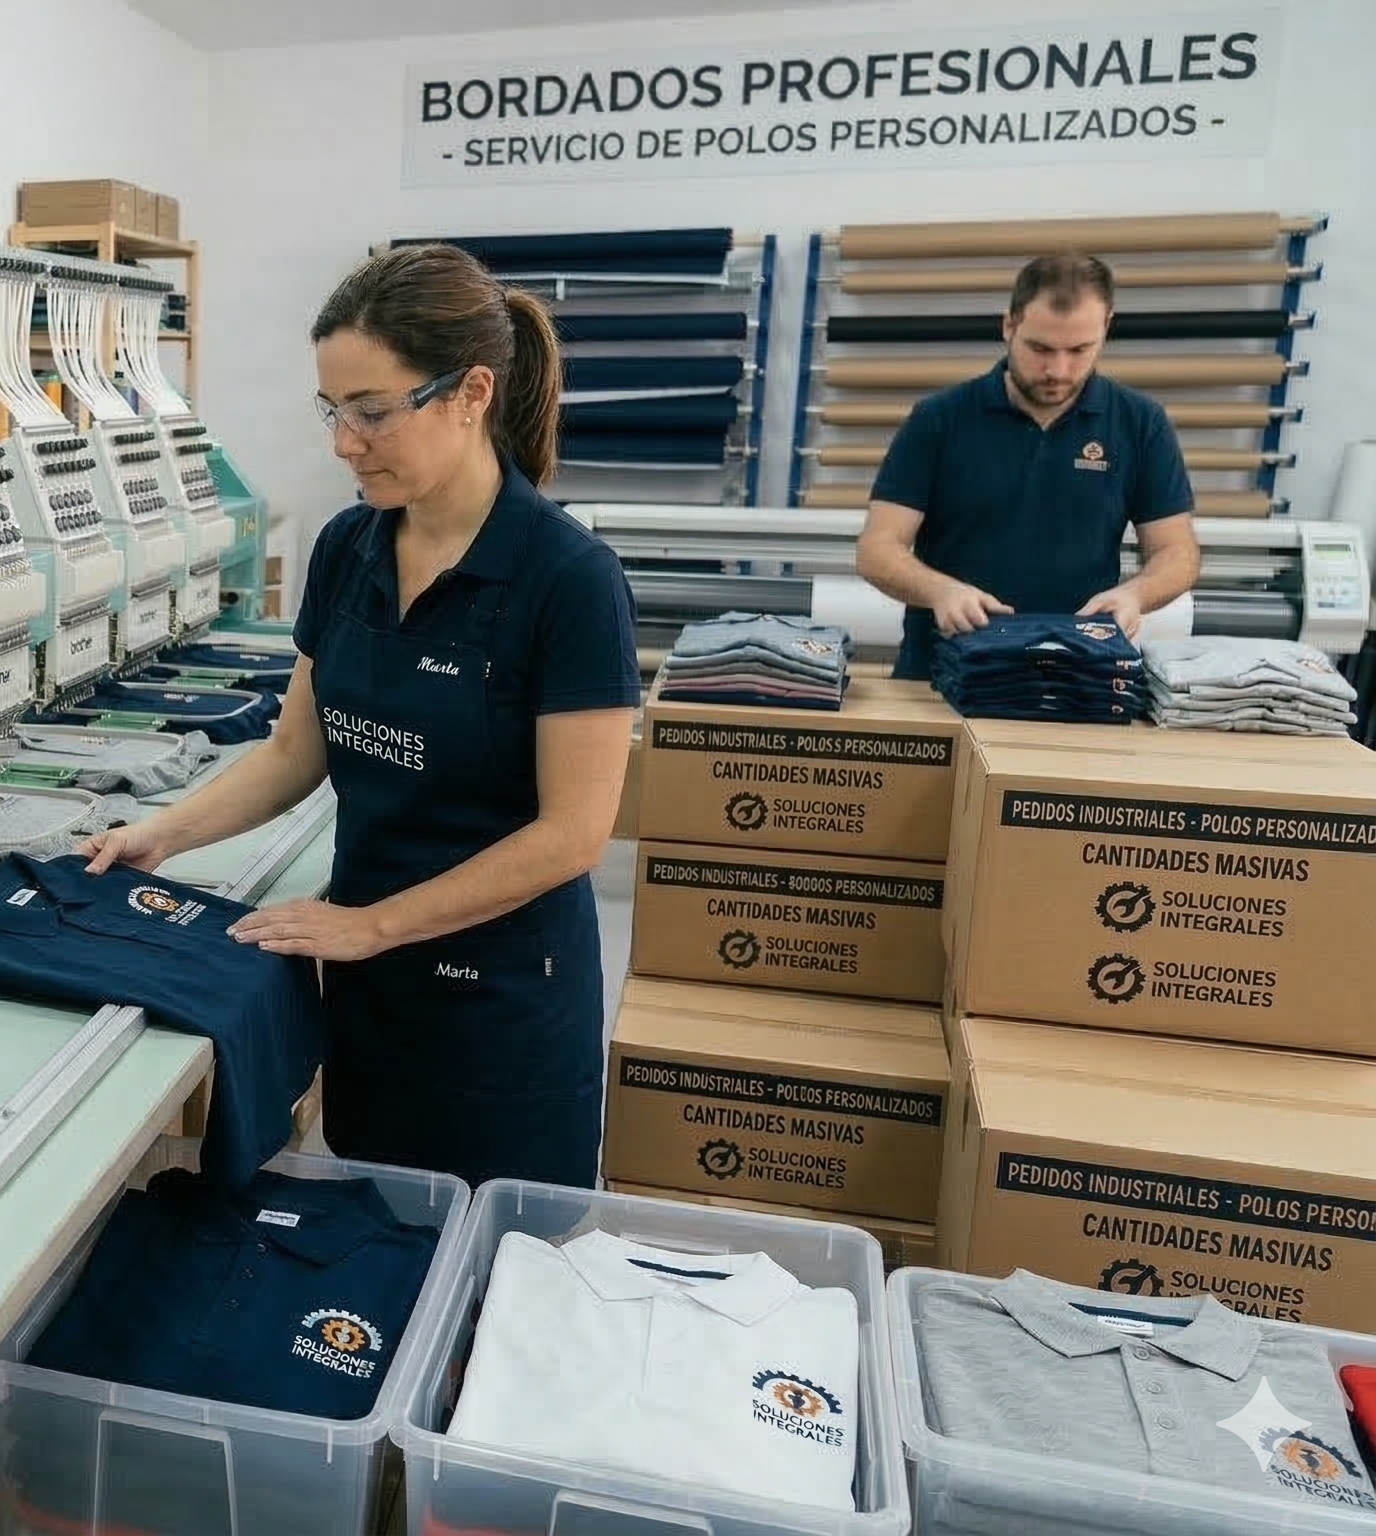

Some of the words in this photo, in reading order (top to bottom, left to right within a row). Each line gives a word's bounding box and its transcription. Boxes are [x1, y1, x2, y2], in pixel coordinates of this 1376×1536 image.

[421, 65, 723, 122] BORDADOS
[742, 32, 1258, 105] PROFESIONALES
[464, 132, 625, 166] SERVICIO
[637, 128, 683, 159] DE
[694, 122, 817, 156] POLOS
[830, 104, 1197, 151] PERSONALIZADOS
[323, 707, 424, 751] SOLUCIONES
[659, 727, 705, 745] PEDIDOS
[708, 730, 787, 750] INDUSTRIALES
[844, 738, 946, 760] PERSONALIZADOS
[327, 726, 424, 770] INTEGRALES
[713, 760, 809, 784] CANTIDADES
[812, 767, 884, 790] MASIVAS
[773, 799, 866, 818] SOLUCIONES
[773, 815, 865, 834] INTEGRALES
[1013, 800, 1075, 823] PEDIDOS
[1079, 804, 1186, 831] INDUSTRIALES
[1201, 813, 1252, 836] POLOS
[1082, 842, 1209, 874] CANTIDADES
[1215, 853, 1310, 882] MASIVAS
[653, 863, 699, 882] PEDIDOS
[701, 868, 778, 888] INDUSTRIALES
[835, 879, 935, 901] PERSONALIZADOS
[706, 898, 802, 923] CANTIDADES
[805, 907, 877, 930] MASIVAS
[1161, 890, 1287, 916] SOLUCIONES
[1160, 911, 1285, 938] INTEGRALES
[765, 936, 858, 957] SOLUCIONES
[765, 952, 858, 974] INTEGRALES
[434, 961, 479, 980] Marta
[1153, 961, 1277, 987] SOLUCIONES
[1151, 982, 1274, 1008] INTEGRALES
[626, 1064, 677, 1086] PEDIDOS
[679, 1071, 765, 1097] INDUSTRIALES
[683, 1103, 786, 1134] CANTIDADES
[790, 1117, 864, 1145] MASIVAS
[747, 1163, 845, 1190] INTEGRALES
[748, 1147, 847, 1173] SOLUCIONES
[1008, 1162, 1083, 1192] PEDIDOS
[1088, 1173, 1220, 1210] INDUSTRIALES
[1238, 1193, 1301, 1221] POLOS
[1083, 1212, 1222, 1254] CANTIDADES
[1228, 1233, 1333, 1272] MASIVAS
[1170, 1270, 1305, 1305] SOLUCIONES
[293, 1335, 376, 1370] SOLUCIONES
[752, 1399, 845, 1437] SOLUCIONES
[753, 1409, 842, 1447] INTEGRALES
